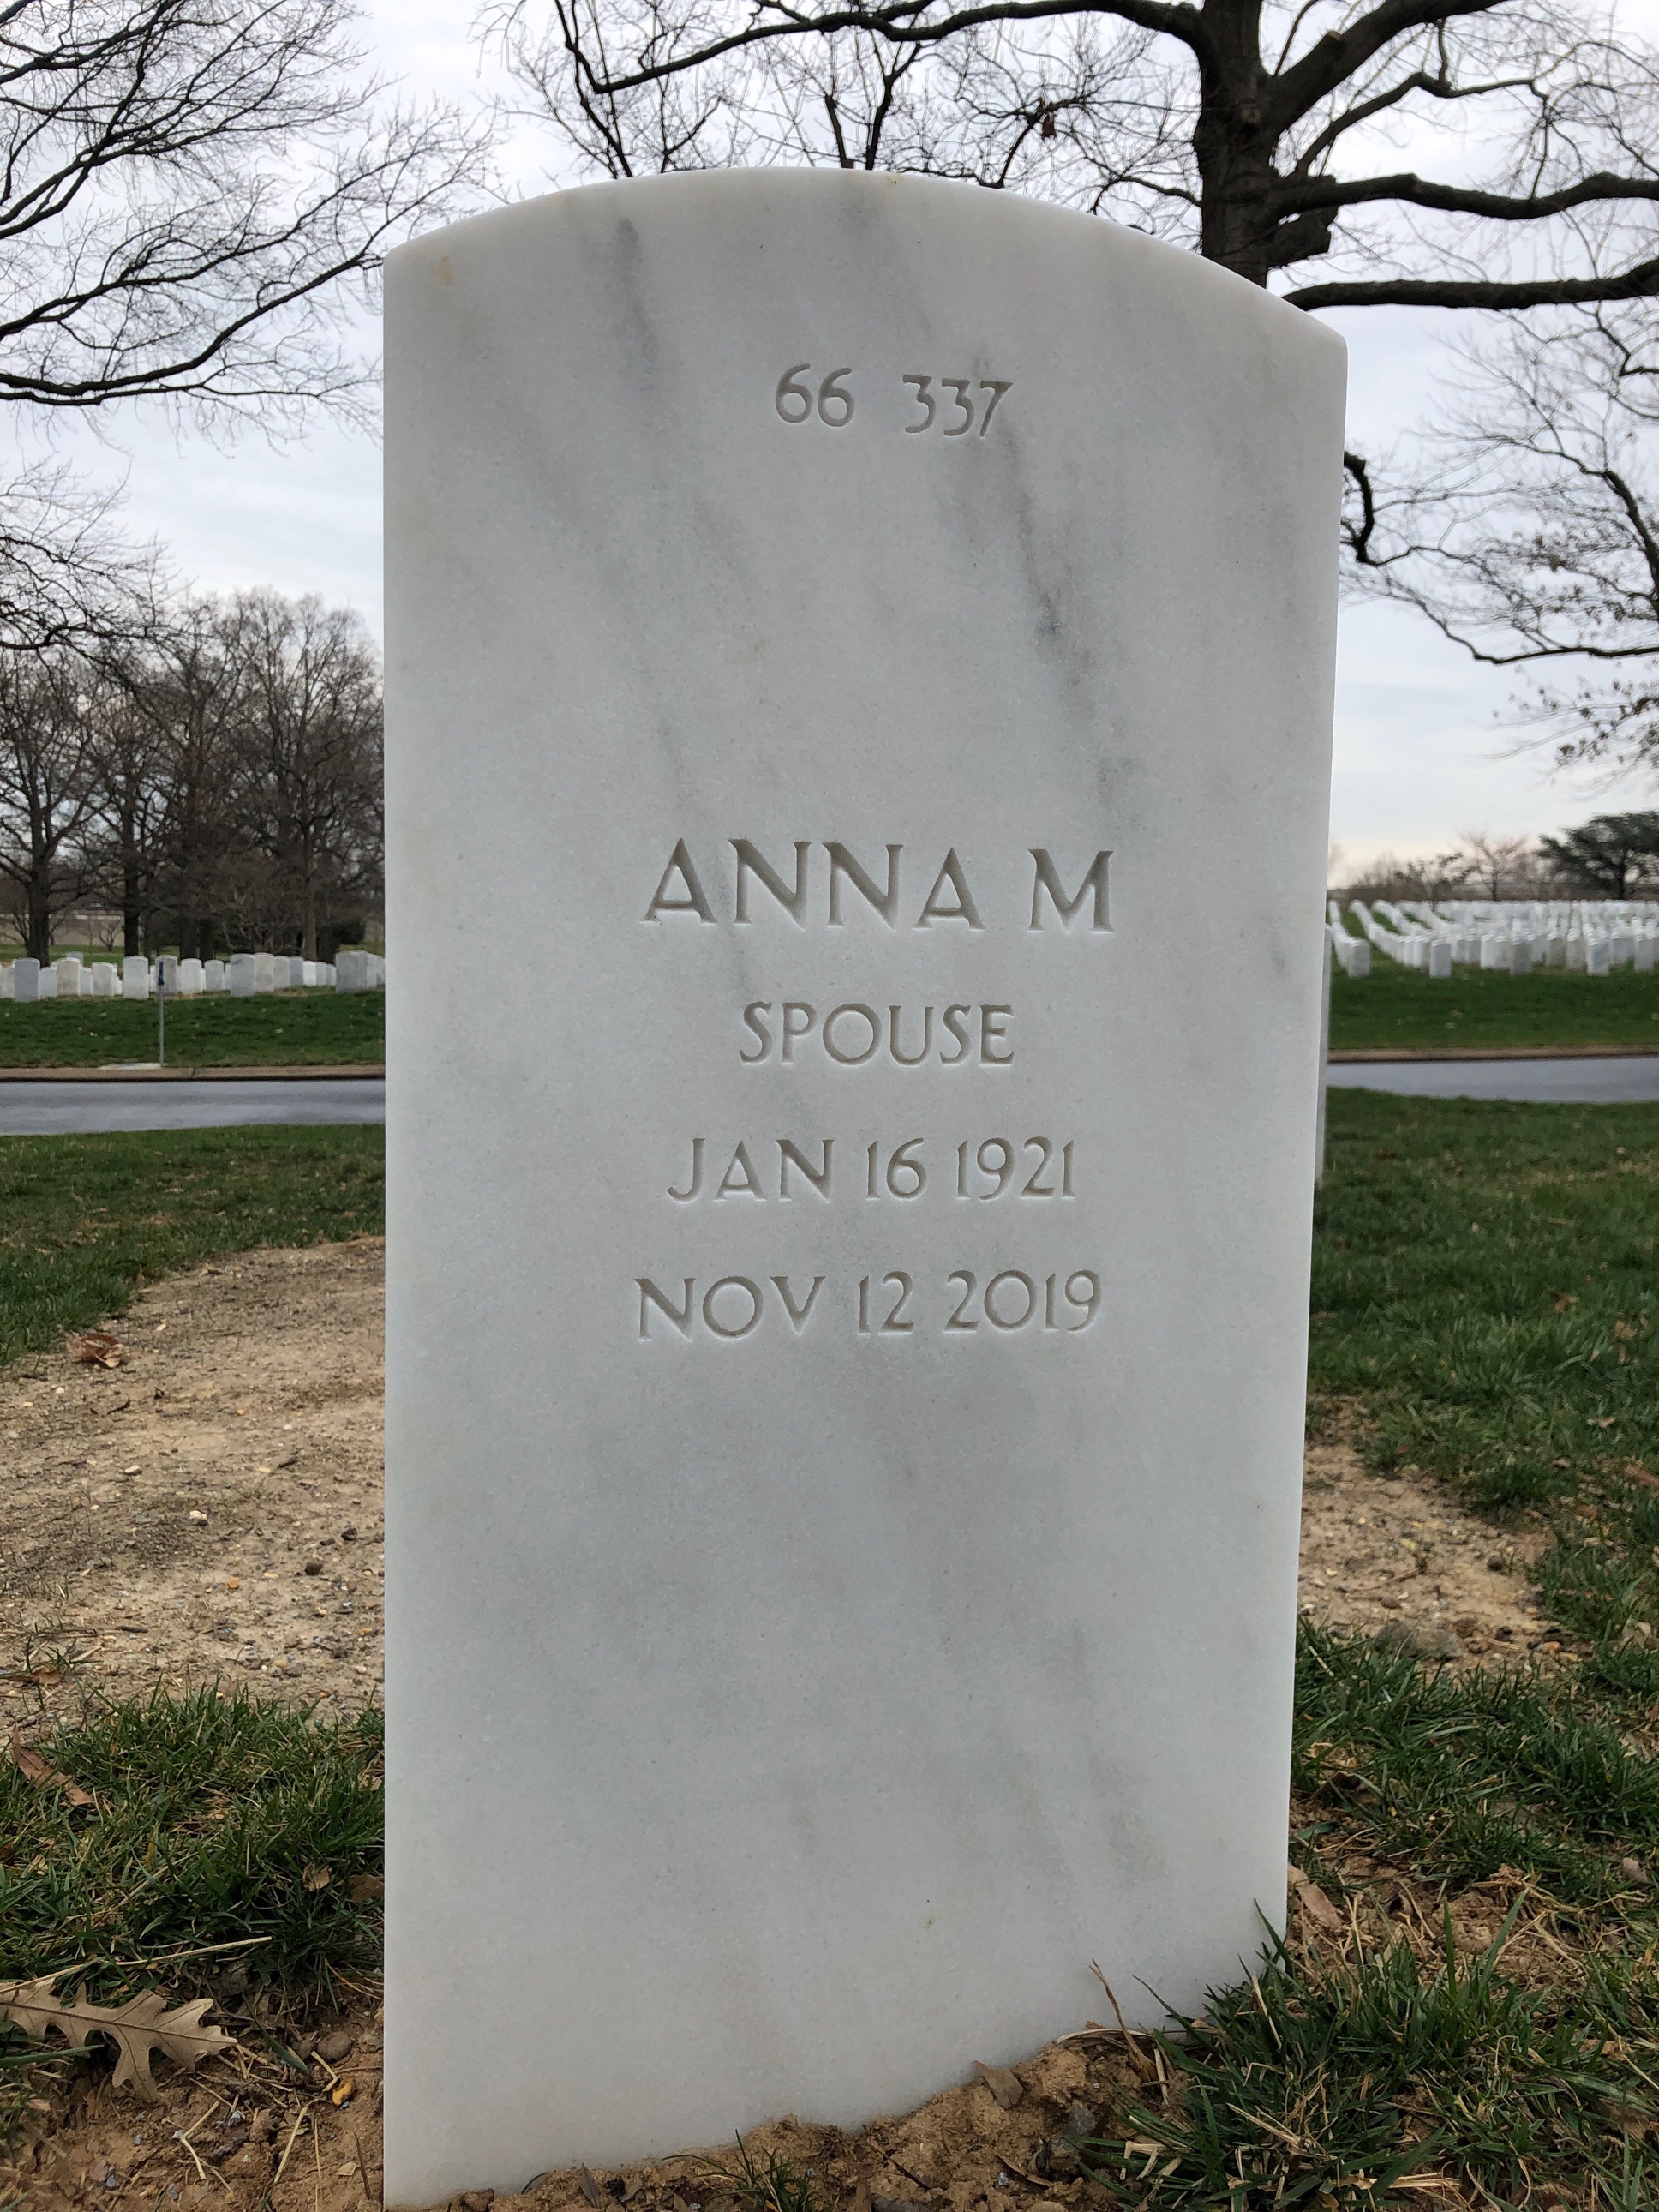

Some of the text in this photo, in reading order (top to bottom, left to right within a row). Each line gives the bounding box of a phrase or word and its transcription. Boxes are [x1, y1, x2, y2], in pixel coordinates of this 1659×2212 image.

[774, 363, 1014, 437] 66 337
[640, 838, 1115, 932] ANNA M
[739, 1001, 1015, 1065] SPOUSE
[667, 1136, 1076, 1203] JAN 16 1921
[634, 1268, 1104, 1340] NOV 12 2019
